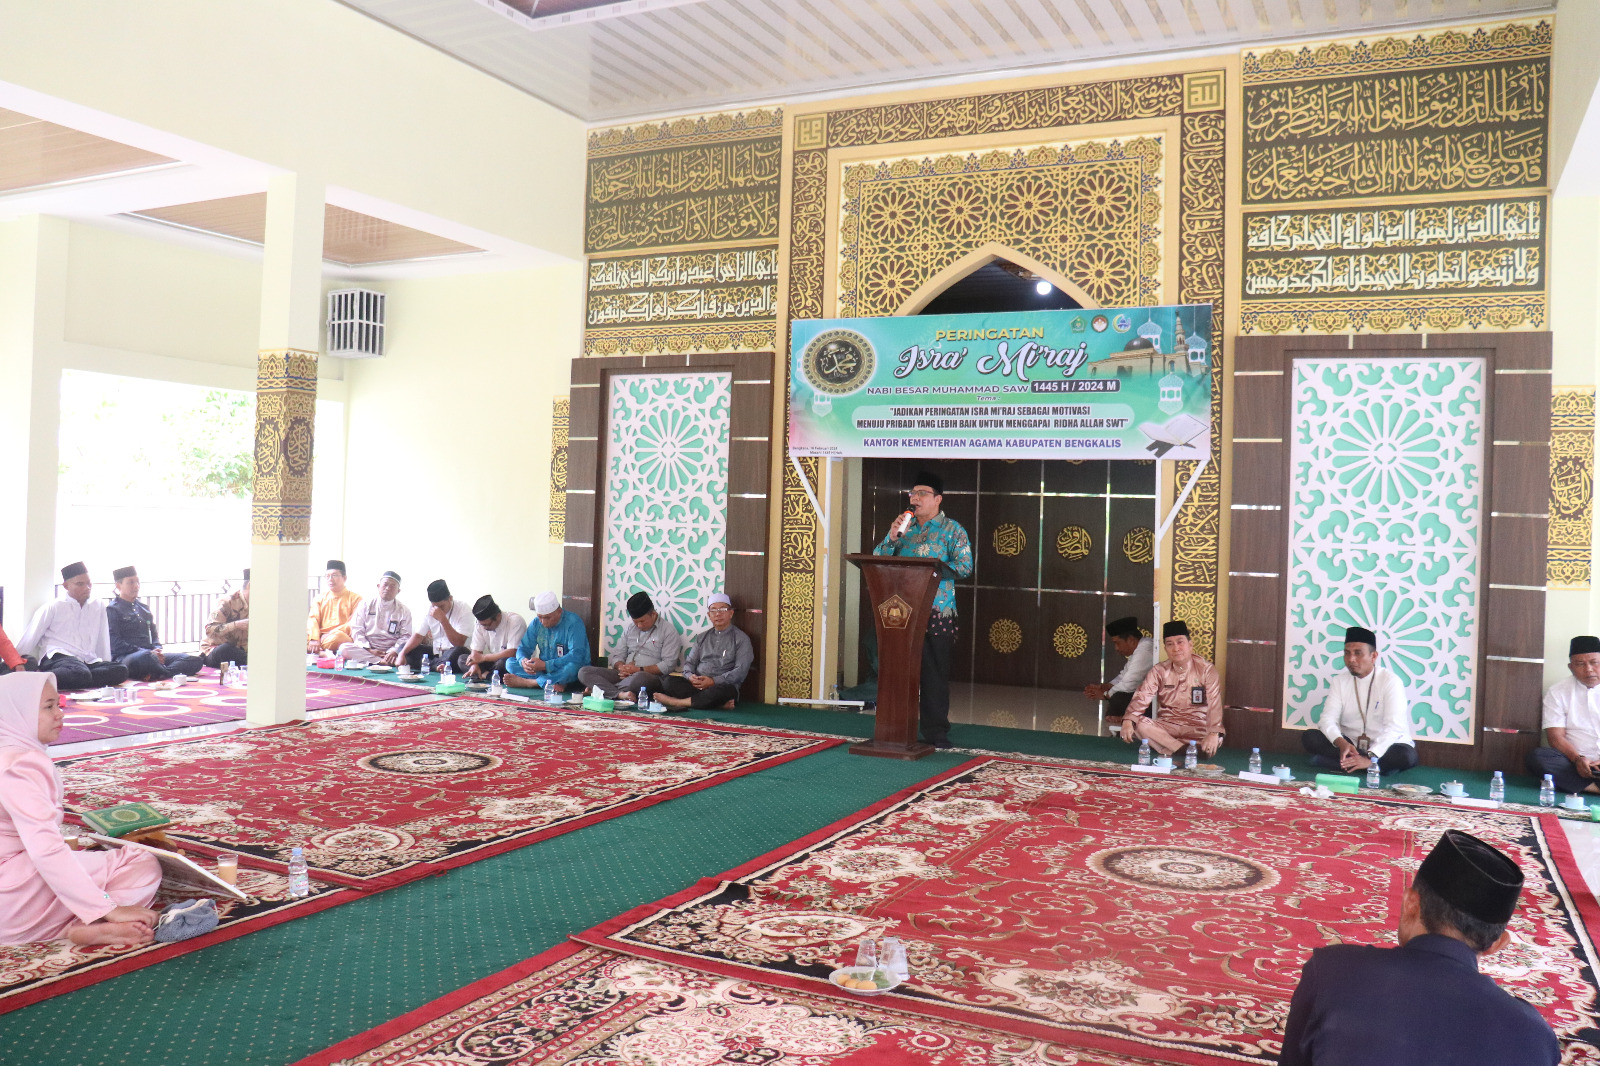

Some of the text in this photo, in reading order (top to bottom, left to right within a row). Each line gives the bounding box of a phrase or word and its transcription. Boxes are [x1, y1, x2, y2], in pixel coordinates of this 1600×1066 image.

[935, 327, 1044, 341] PERINGATAN
[867, 387, 892, 395] NABI
[895, 386, 929, 395] BESAR
[932, 385, 1000, 394] MUHAMMAD
[1002, 385, 1029, 393] SAW
[1033, 382, 1058, 392] 1445
[1061, 382, 1069, 392] H
[1078, 381, 1104, 391] 2024
[1106, 381, 1117, 391] M
[925, 407, 969, 416] PERINGATAN
[971, 406, 989, 416] ISRA
[1017, 406, 1050, 415] SEBAGAI
[1051, 406, 1091, 415] MOTIVASI
[857, 420, 885, 429] MENUJU
[885, 419, 915, 429] PRIBADI
[916, 419, 936, 428] YANG
[937, 419, 957, 428] LEBIH
[959, 419, 977, 428] BAIK
[978, 419, 1006, 428] UNTUK
[1006, 419, 1050, 428] MENGGAPAI
[1054, 419, 1078, 428] RIDHA
[1080, 419, 1104, 428] ALLAH
[863, 439, 1121, 448] KANTOR KEMENTERIAN AGAMA KABUPATEN BENGKALIS
